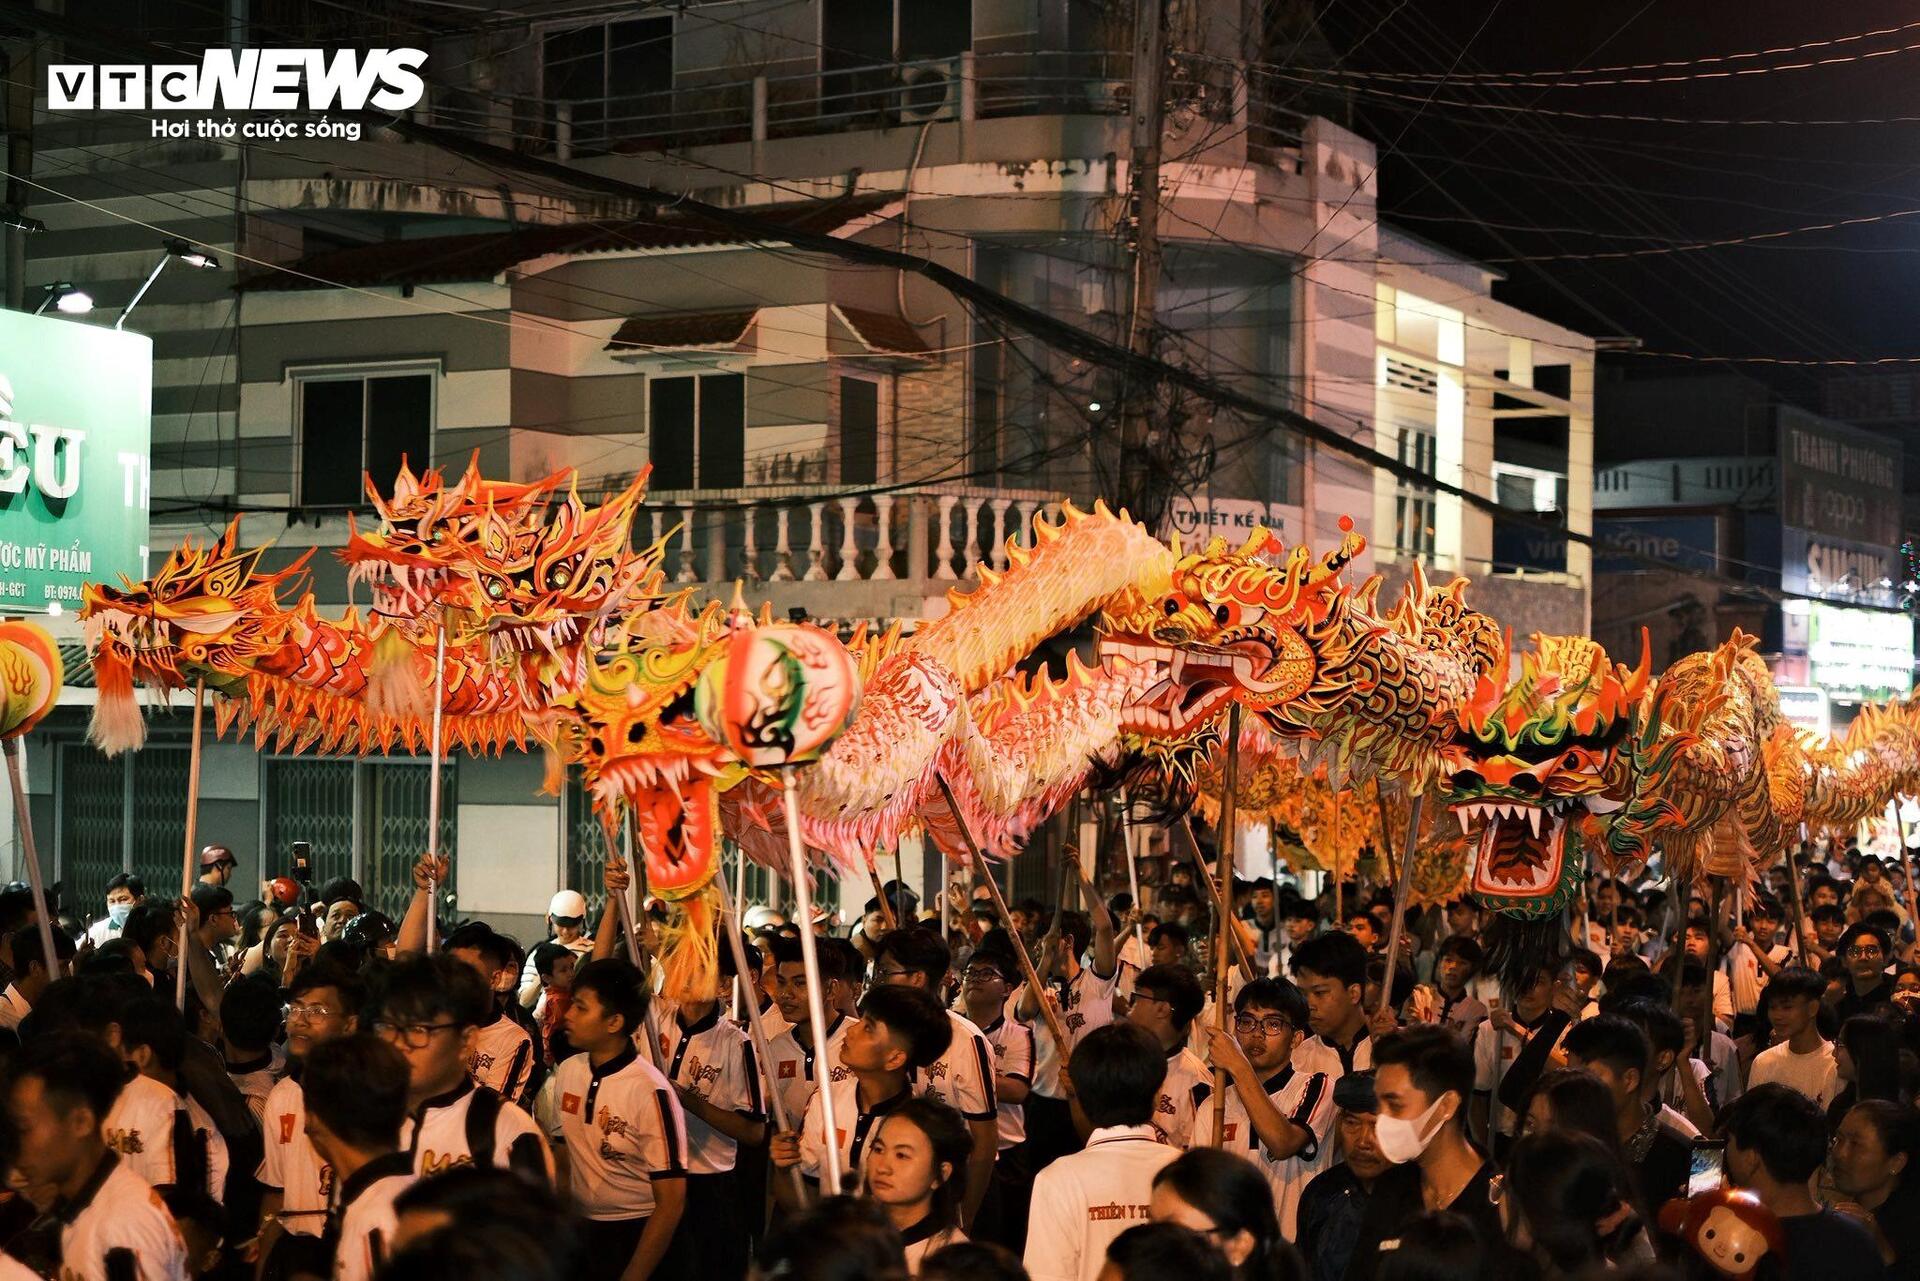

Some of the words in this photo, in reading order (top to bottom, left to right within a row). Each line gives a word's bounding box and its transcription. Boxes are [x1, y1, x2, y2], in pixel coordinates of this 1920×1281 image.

[1176, 506, 1229, 525] THIẾT
[1234, 509, 1255, 528] KẾ
[25, 543, 47, 571] MỸ
[49, 538, 91, 574] PHẨM
[1088, 1201, 1126, 1221] THIÊN
[1128, 1205, 1137, 1219] Y
